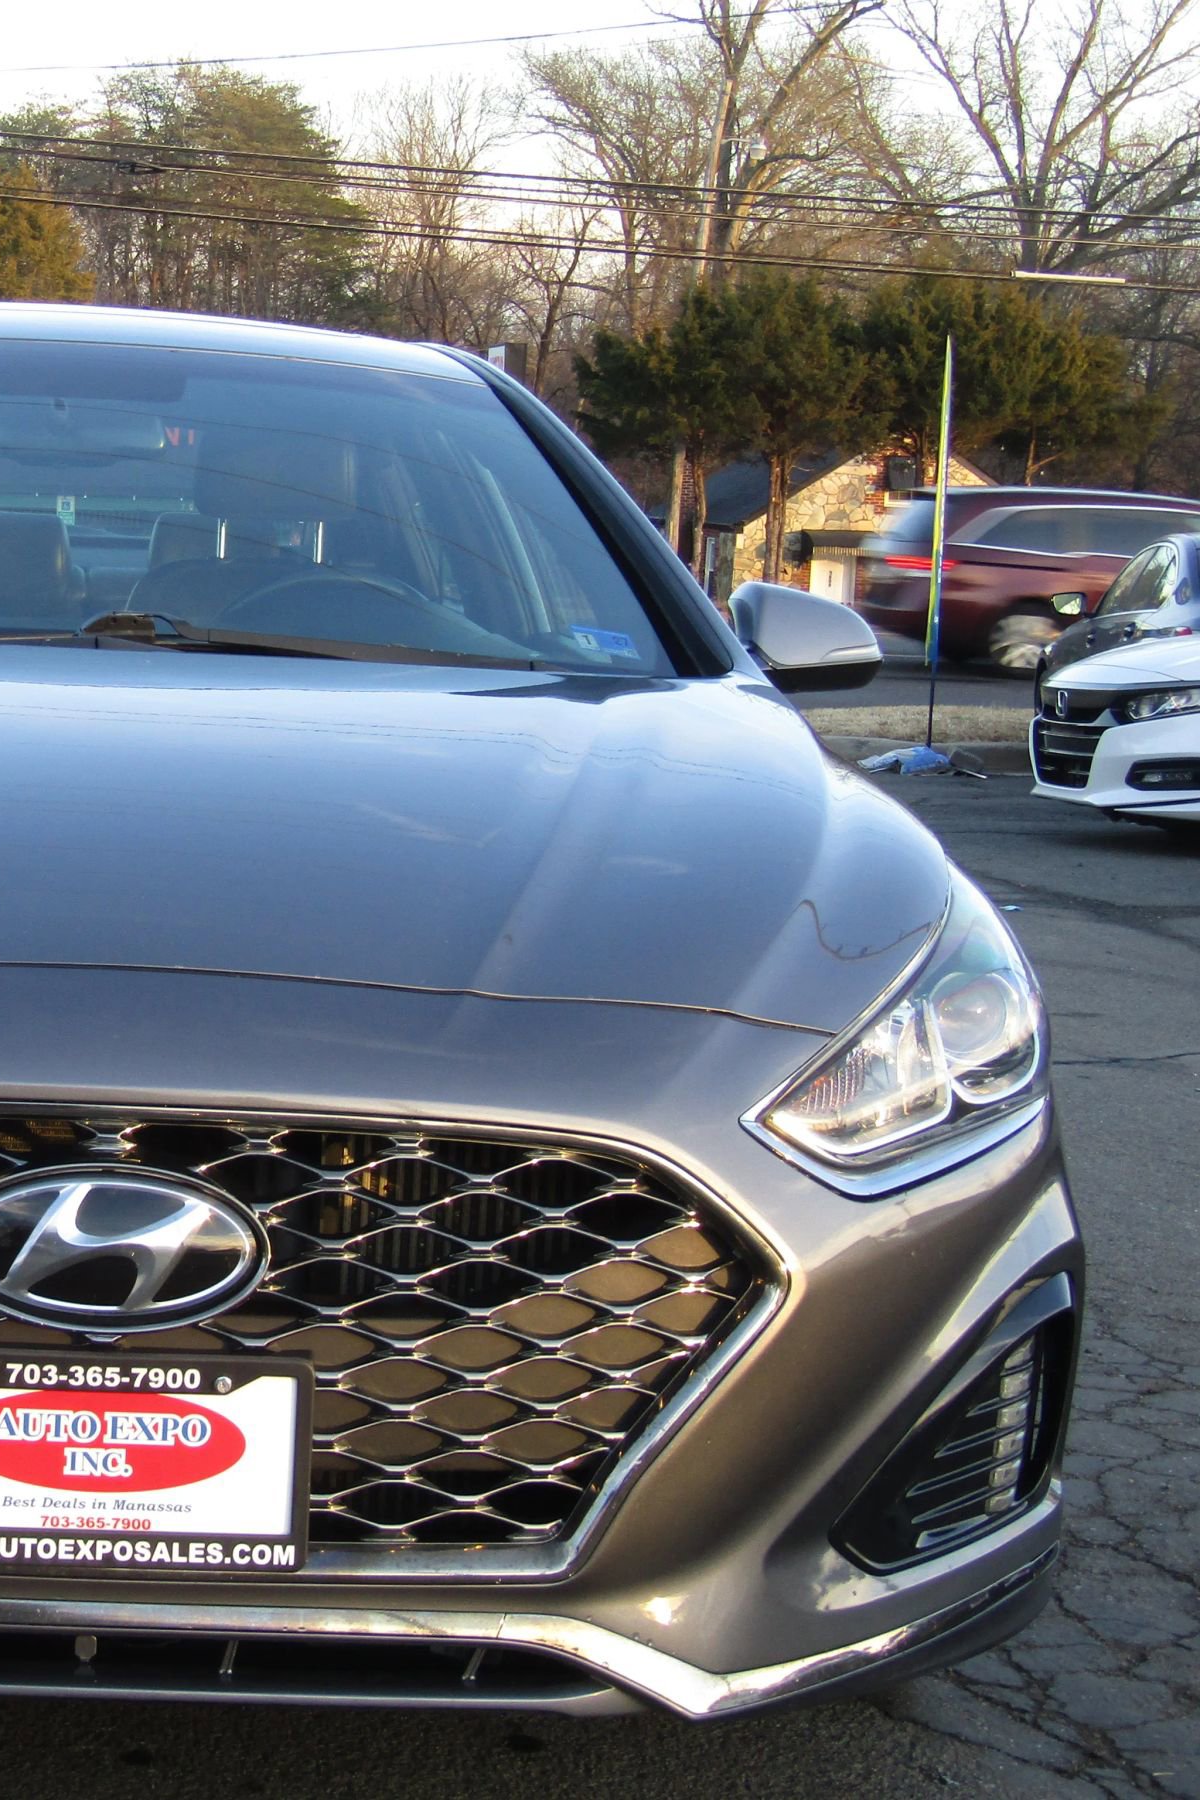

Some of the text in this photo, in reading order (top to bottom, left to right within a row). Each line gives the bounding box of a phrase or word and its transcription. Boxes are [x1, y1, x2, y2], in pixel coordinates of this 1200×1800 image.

[6, 1363, 201, 1390] 703-365-7900
[104, 1411, 211, 1447] EXPO
[63, 1448, 132, 1477] INC.
[2, 1495, 192, 1513] Best Deals in Manassas
[40, 1515, 151, 1531] 703-365-7900
